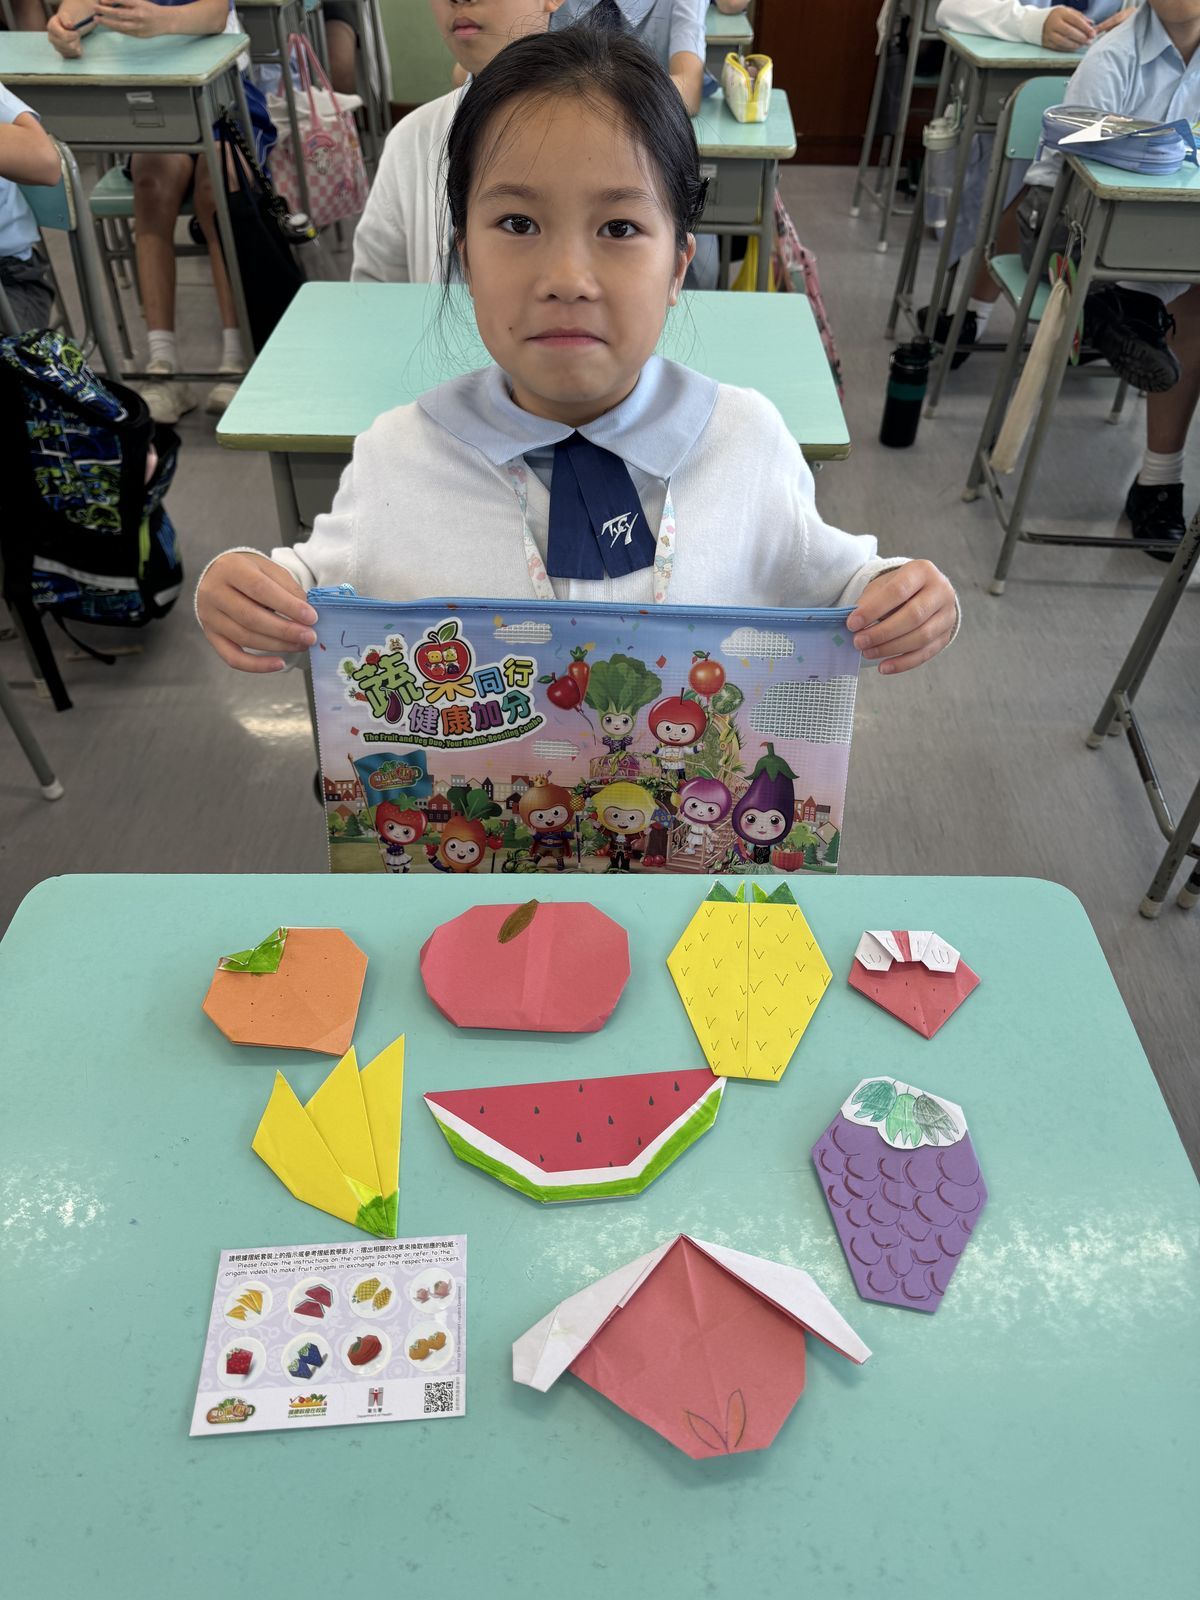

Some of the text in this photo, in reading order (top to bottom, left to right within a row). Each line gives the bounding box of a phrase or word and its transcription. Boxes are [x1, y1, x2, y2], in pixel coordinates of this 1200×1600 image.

[352, 636, 534, 720] 蔬果同行
[408, 690, 531, 736] 健康加分
[364, 715, 543, 749] The Fruit and Veg Duo, Your Health-Boosting Combo
[294, 1257, 329, 1265] instructions
[353, 1254, 375, 1263] origami
[377, 1252, 402, 1261] package
[314, 1264, 337, 1272] origami
[346, 1261, 376, 1269] exchange
[401, 1258, 433, 1266] respective
